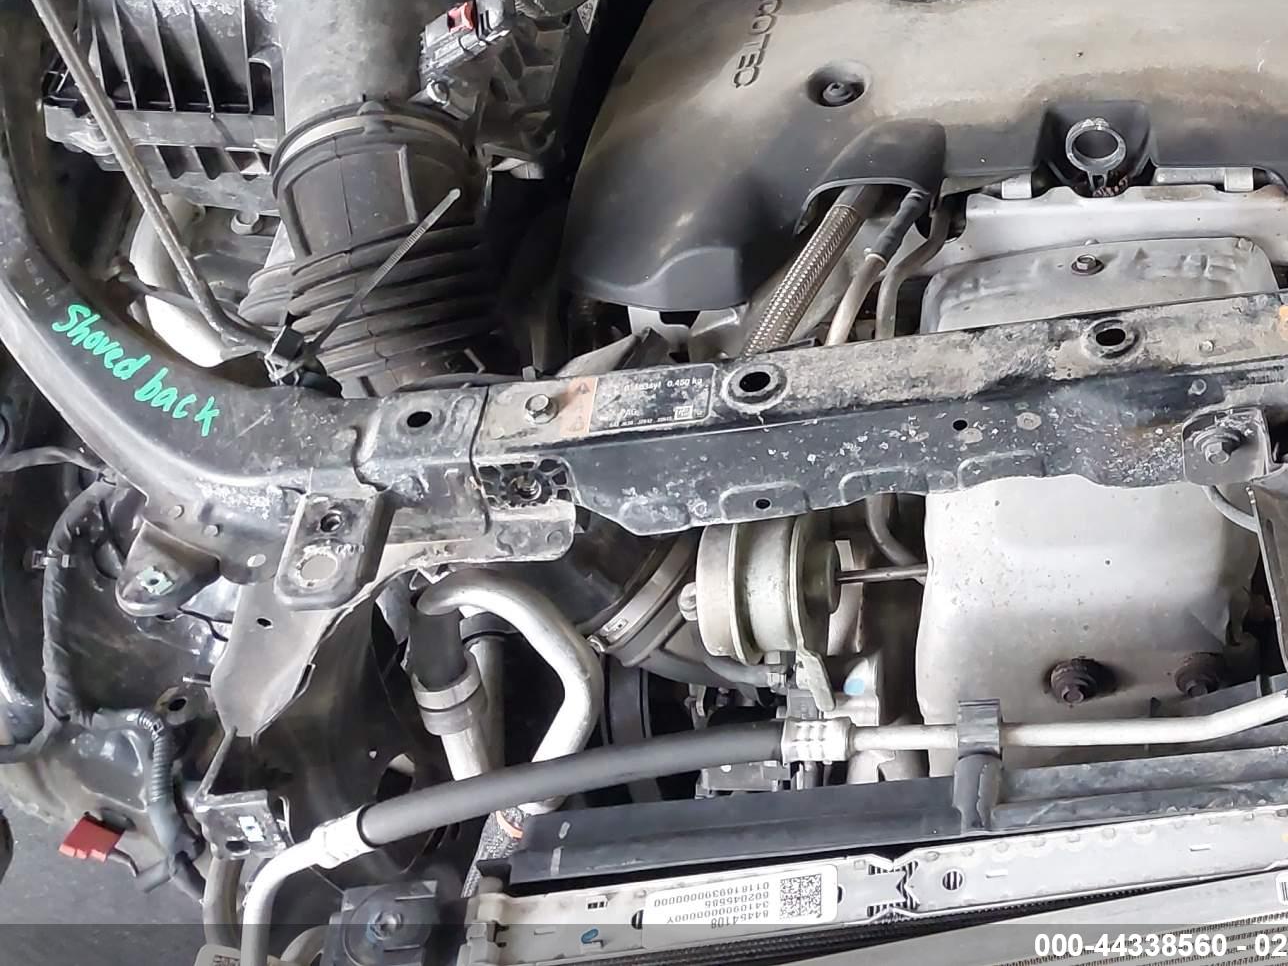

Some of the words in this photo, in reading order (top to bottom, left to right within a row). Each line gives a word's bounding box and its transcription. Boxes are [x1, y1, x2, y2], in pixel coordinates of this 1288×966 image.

[52, 303, 152, 380] Shoved
[134, 366, 220, 437] back
[666, 378, 690, 387] 0.450
[691, 376, 703, 387] kg
